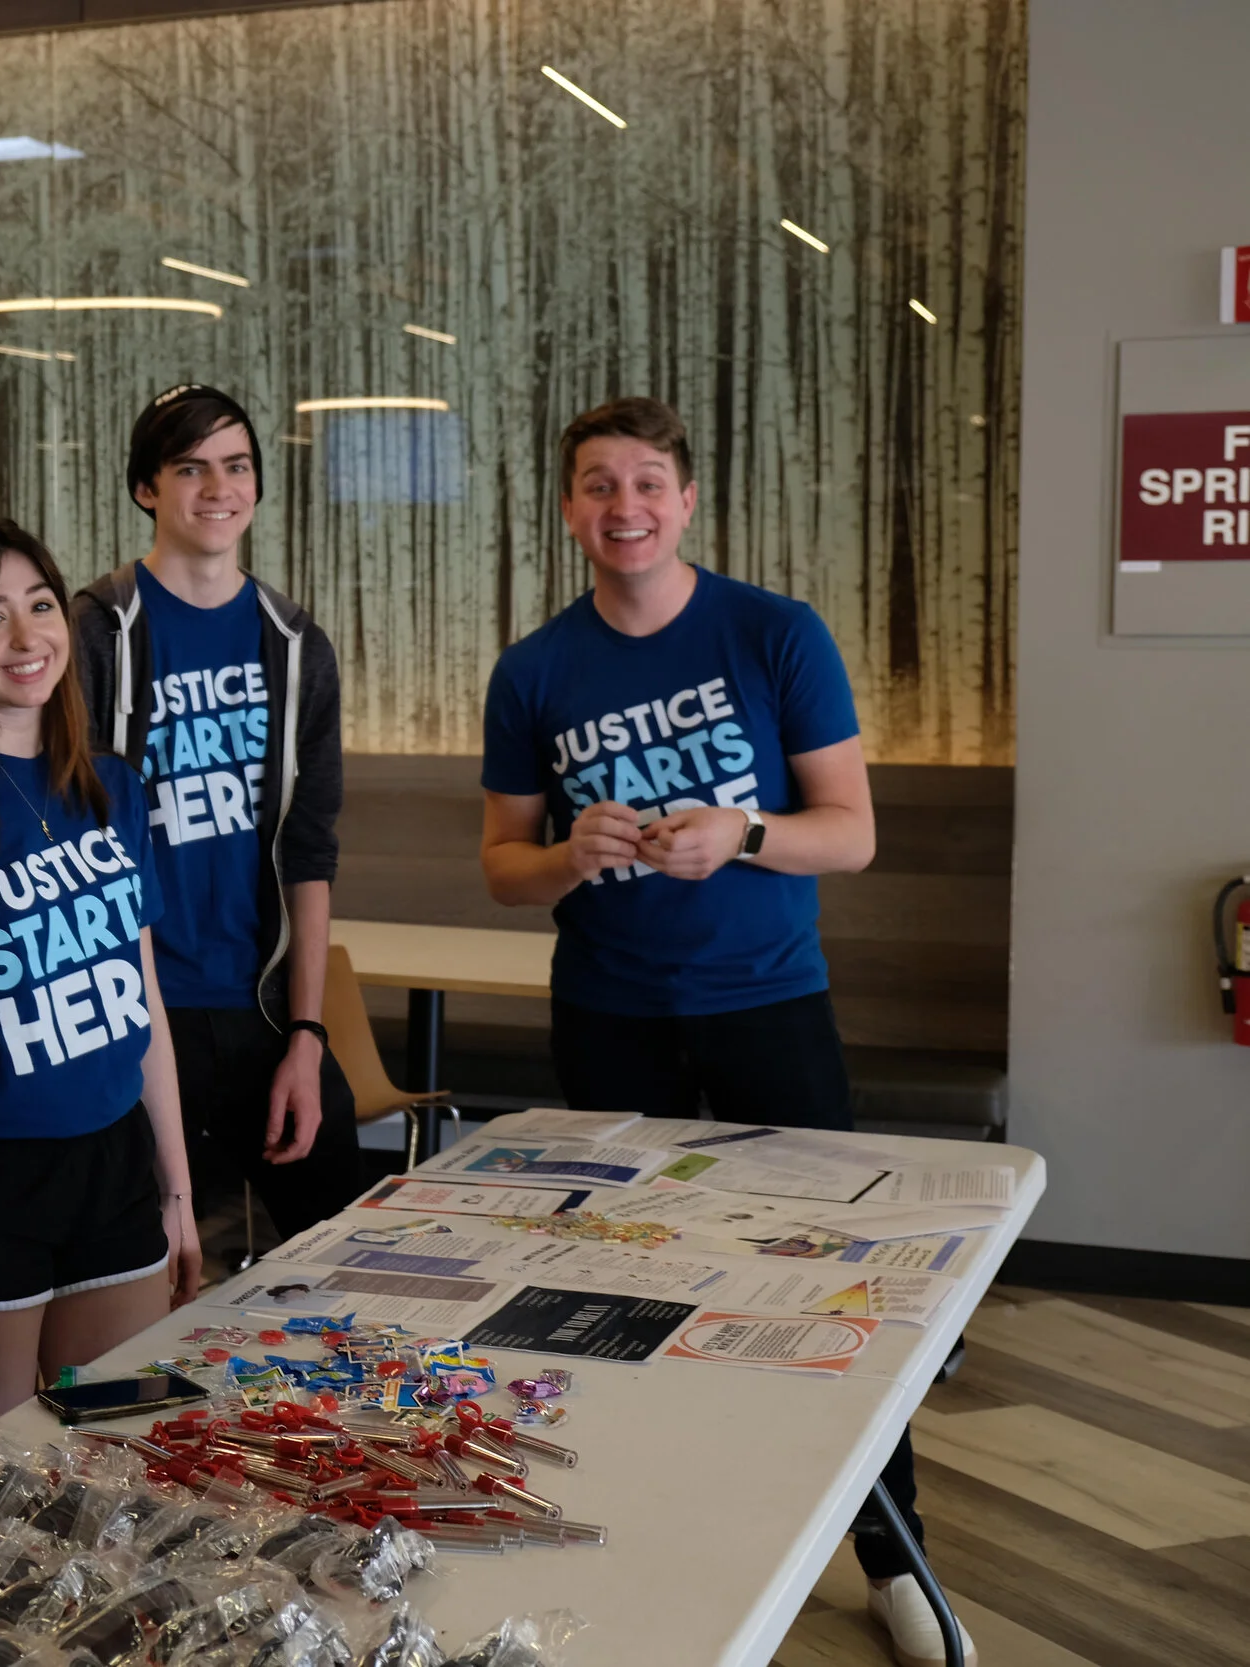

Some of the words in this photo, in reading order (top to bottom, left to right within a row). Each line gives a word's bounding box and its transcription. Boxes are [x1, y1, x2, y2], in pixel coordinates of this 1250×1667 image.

[140, 706, 268, 784] TARTS
[552, 677, 735, 775] JUSTICE
[562, 721, 755, 820] STARTS
